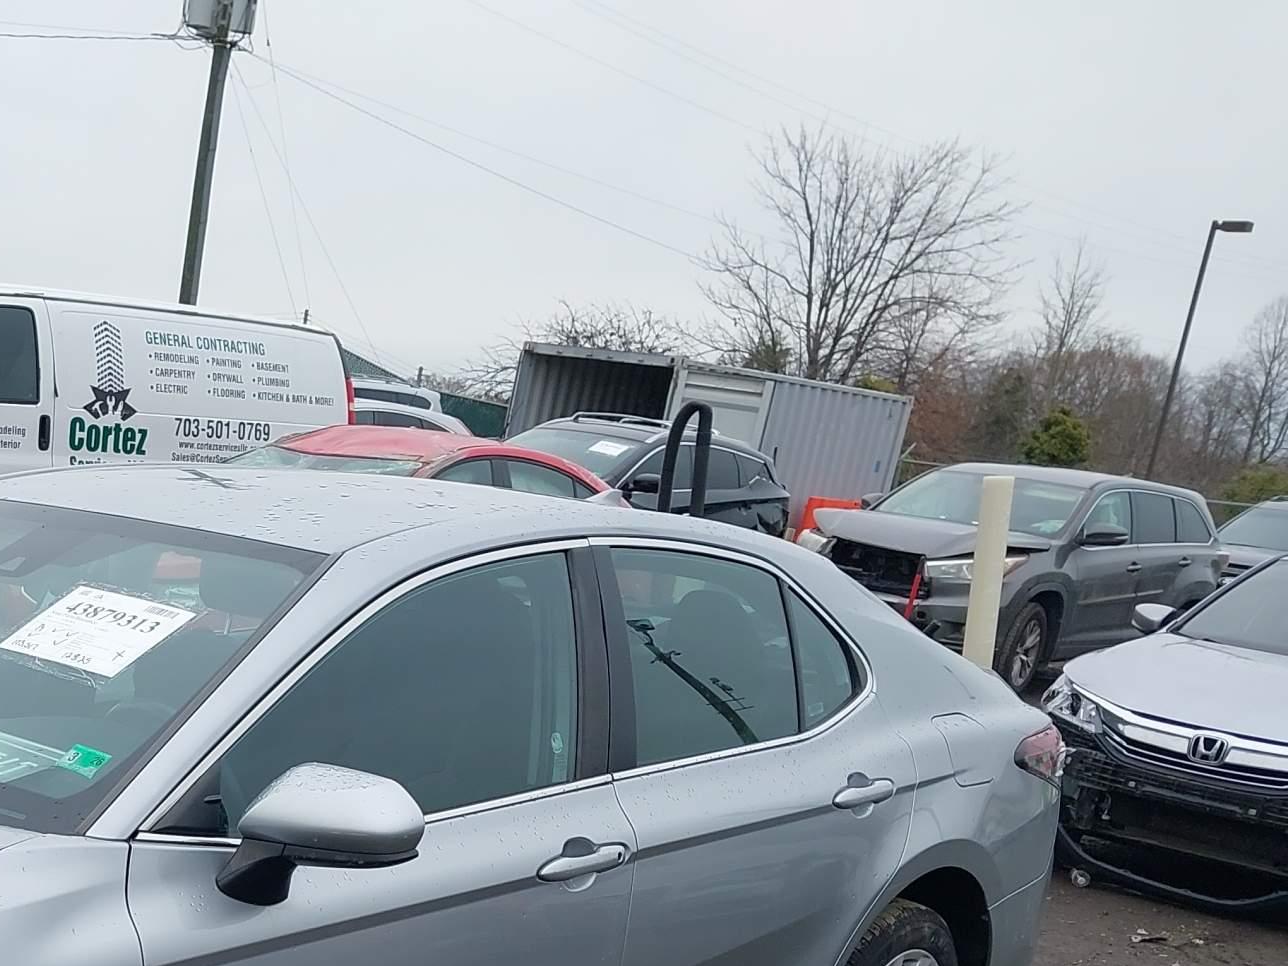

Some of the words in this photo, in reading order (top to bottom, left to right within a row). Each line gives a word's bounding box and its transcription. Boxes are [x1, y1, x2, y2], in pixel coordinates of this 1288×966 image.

[145, 331, 193, 349] GENERAL
[196, 337, 265, 356] CONTRACTING
[154, 352, 199, 365] REMODELING
[211, 357, 241, 369] PAINTING
[256, 362, 289, 373] BASEMENT
[155, 368, 196, 380] CARPENTRY
[212, 373, 244, 384] DRYWALL
[156, 383, 188, 394] ELECTRIC
[257, 377, 290, 388] PLUMBING
[213, 388, 245, 399] FLOORING
[257, 392, 284, 403] KITCHEN
[292, 394, 307, 404] BATH
[174, 417, 270, 441] 703-501-0769
[69, 416, 148, 455] Cortez
[65, 601, 161, 634] 43879313
